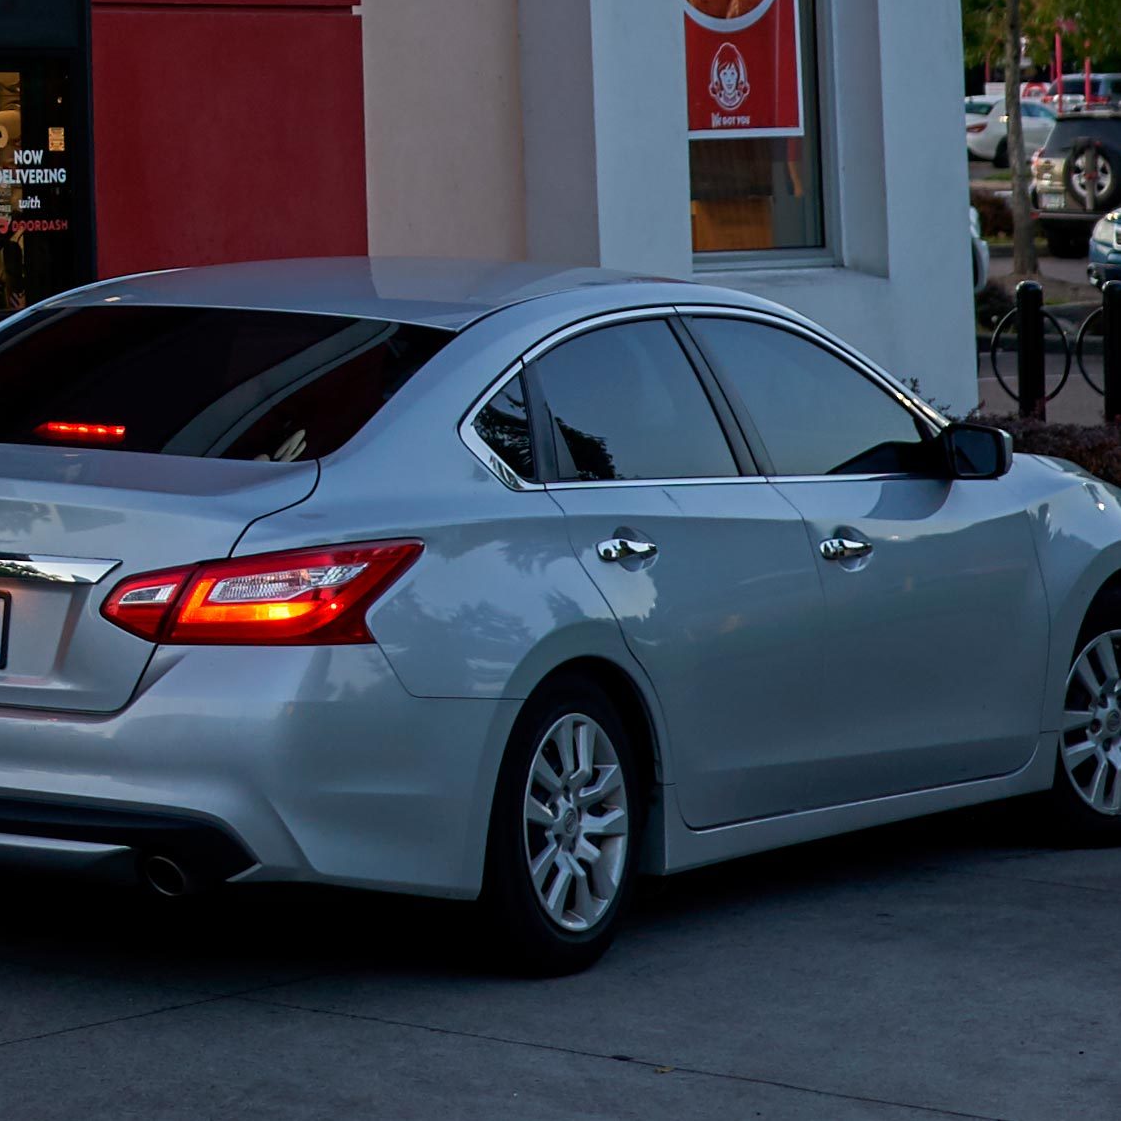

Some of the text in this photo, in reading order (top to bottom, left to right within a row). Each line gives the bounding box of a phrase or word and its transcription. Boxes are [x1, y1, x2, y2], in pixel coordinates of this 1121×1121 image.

[14, 149, 44, 165] NOW
[19, 196, 41, 209] with
[12, 219, 69, 232] DOORDASH
